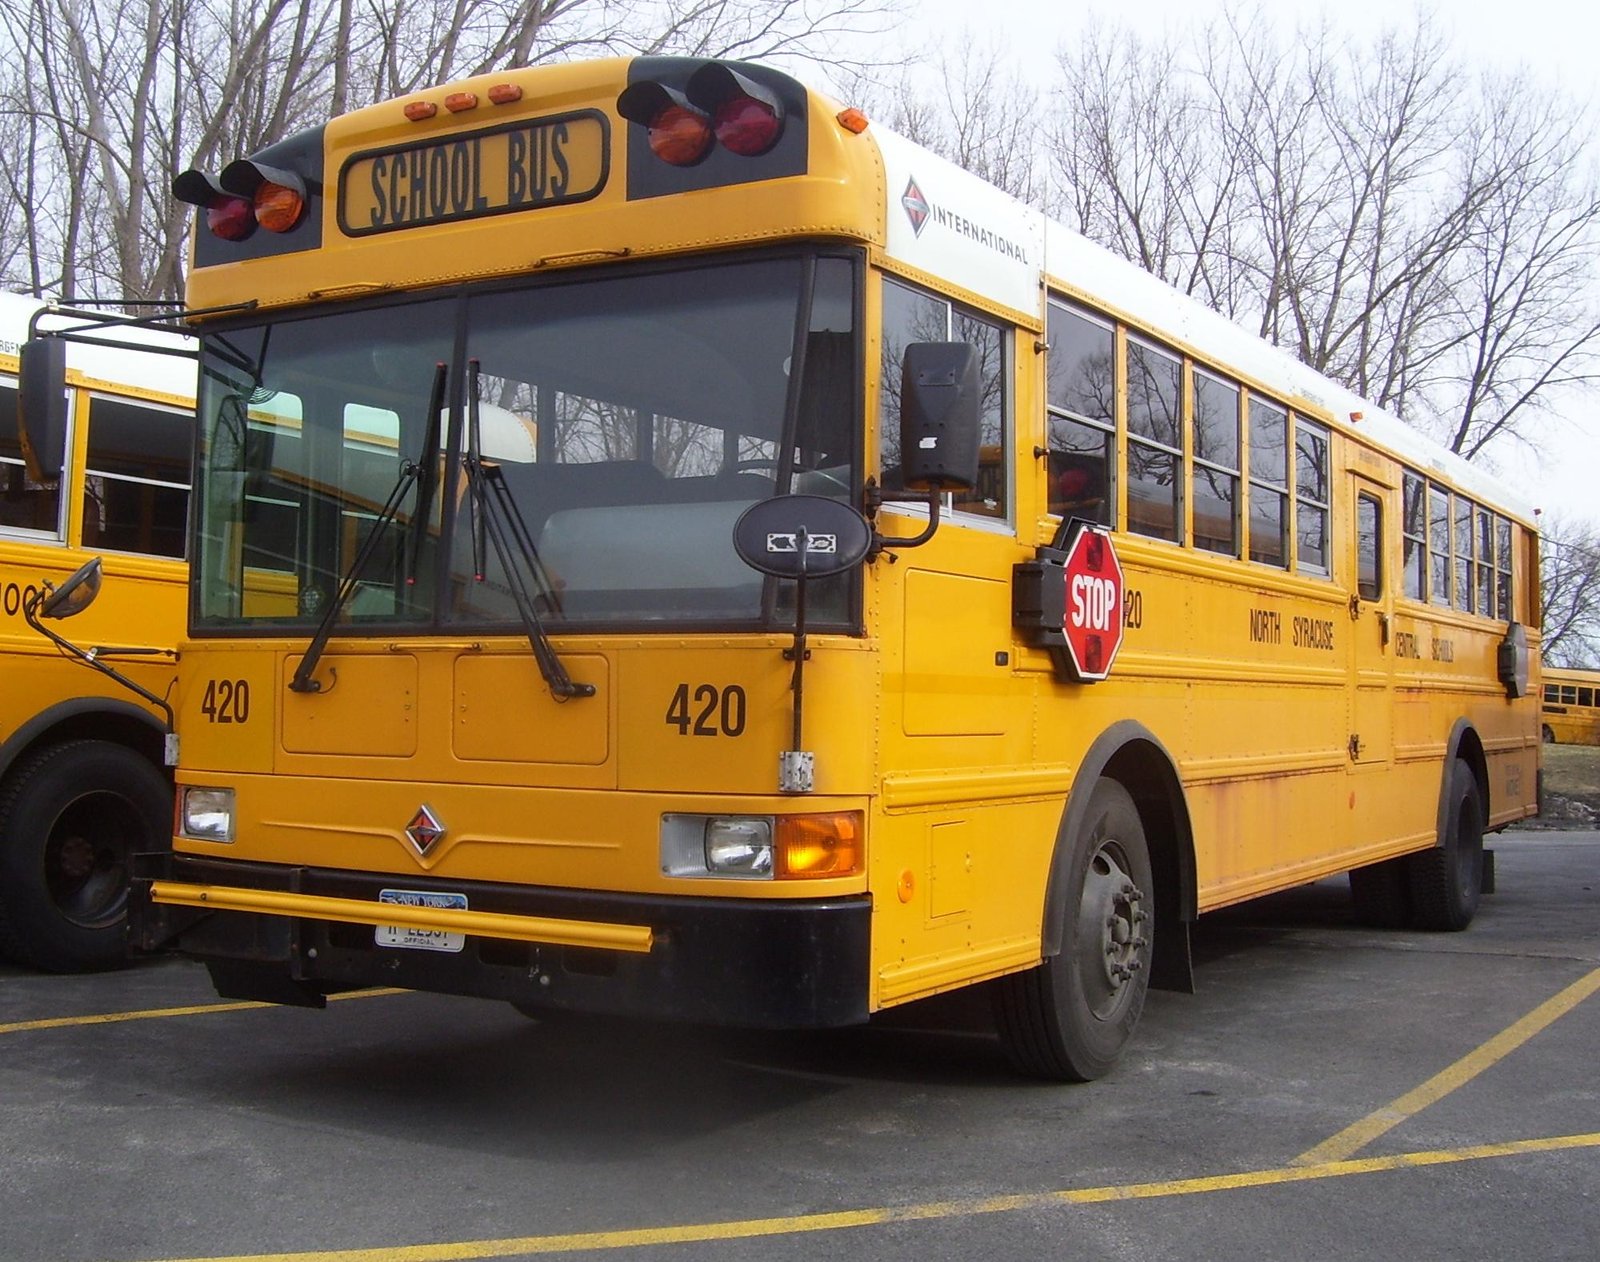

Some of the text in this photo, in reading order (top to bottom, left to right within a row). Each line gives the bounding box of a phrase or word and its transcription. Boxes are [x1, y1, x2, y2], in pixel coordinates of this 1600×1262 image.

[370, 122, 569, 227] SCHOOL BUS
[932, 203, 1029, 265] INTERNATIONAL
[1071, 573, 1116, 631] STOP
[1250, 608, 1281, 645] NORTH
[1292, 615, 1334, 650] SYRACUSE
[201, 679, 249, 724] 420
[665, 683, 746, 737] 420
[403, 936, 434, 946] OFFICIAL
